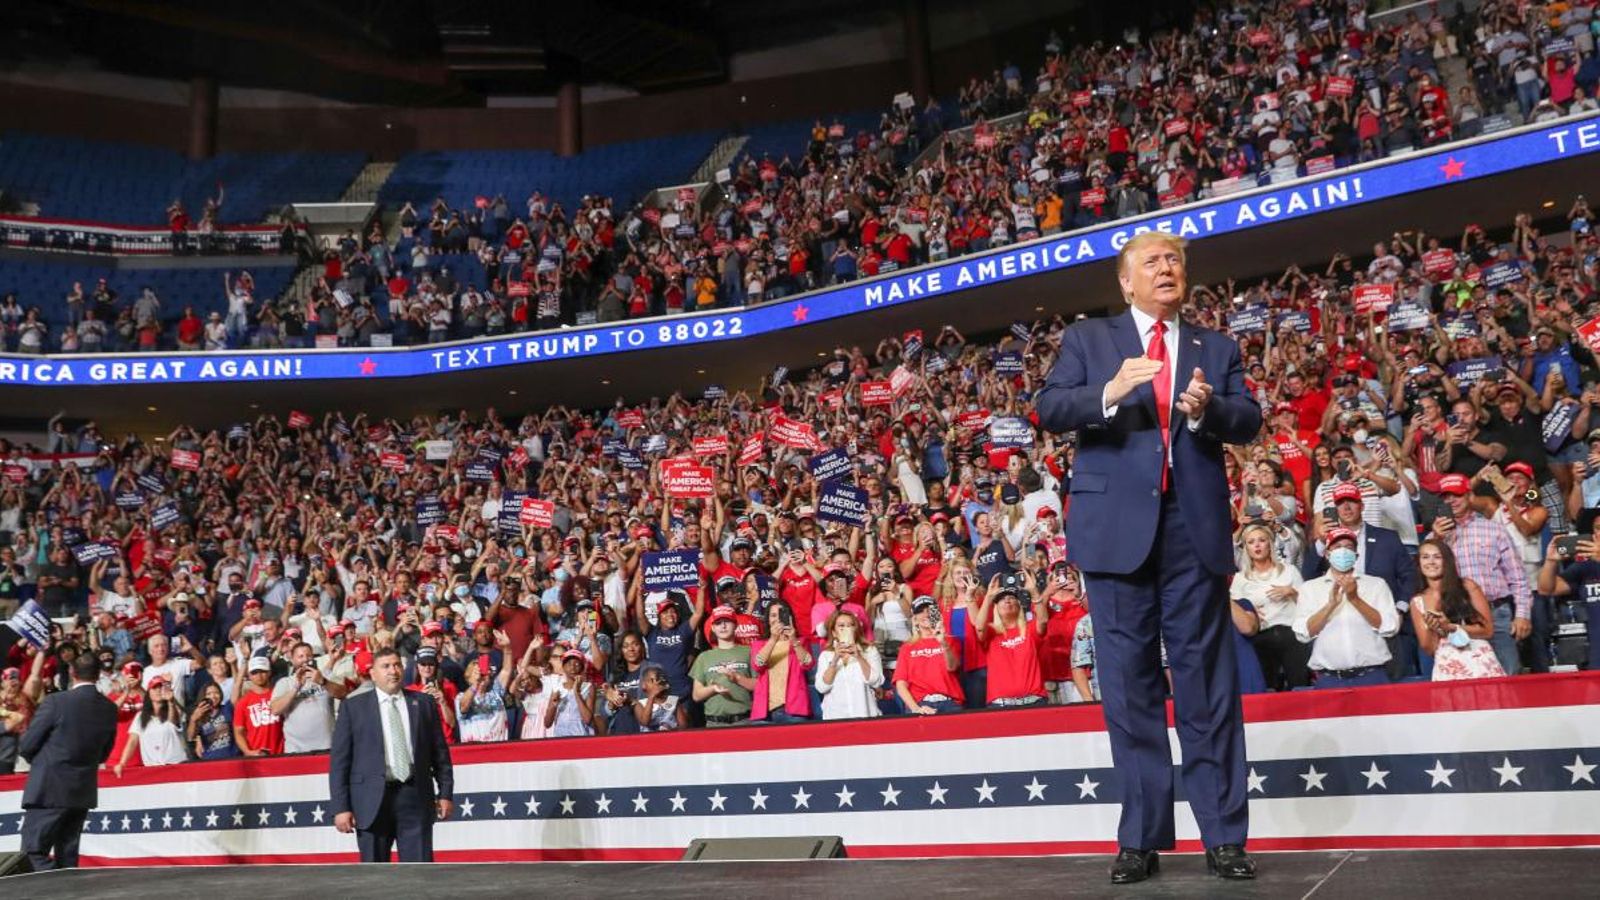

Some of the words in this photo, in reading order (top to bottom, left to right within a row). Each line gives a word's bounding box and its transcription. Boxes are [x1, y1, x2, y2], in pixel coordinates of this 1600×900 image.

[865, 273, 942, 306] MAKE
[957, 239, 1095, 286] AMERICA
[1236, 179, 1365, 225] AGAIN!
[1486, 268, 1520, 281] AMERICA
[1389, 309, 1430, 320] AMERICA
[432, 347, 496, 369] TEXT
[508, 334, 597, 360] TRUMP
[611, 329, 645, 348] TO
[658, 317, 743, 344] 88022
[0, 362, 75, 382] RICA
[90, 361, 186, 381] GREAT
[199, 358, 302, 379] AGAIN!
[774, 424, 807, 440] AMERICA
[813, 456, 851, 476] AMERICA
[671, 476, 713, 487] AMERICA
[836, 488, 856, 500] MAKE
[820, 504, 843, 517] GREAT
[821, 494, 867, 513] AMERICA
[659, 556, 682, 567] MAKE
[645, 562, 698, 577] AMERICA
[645, 575, 671, 585] GREAT
